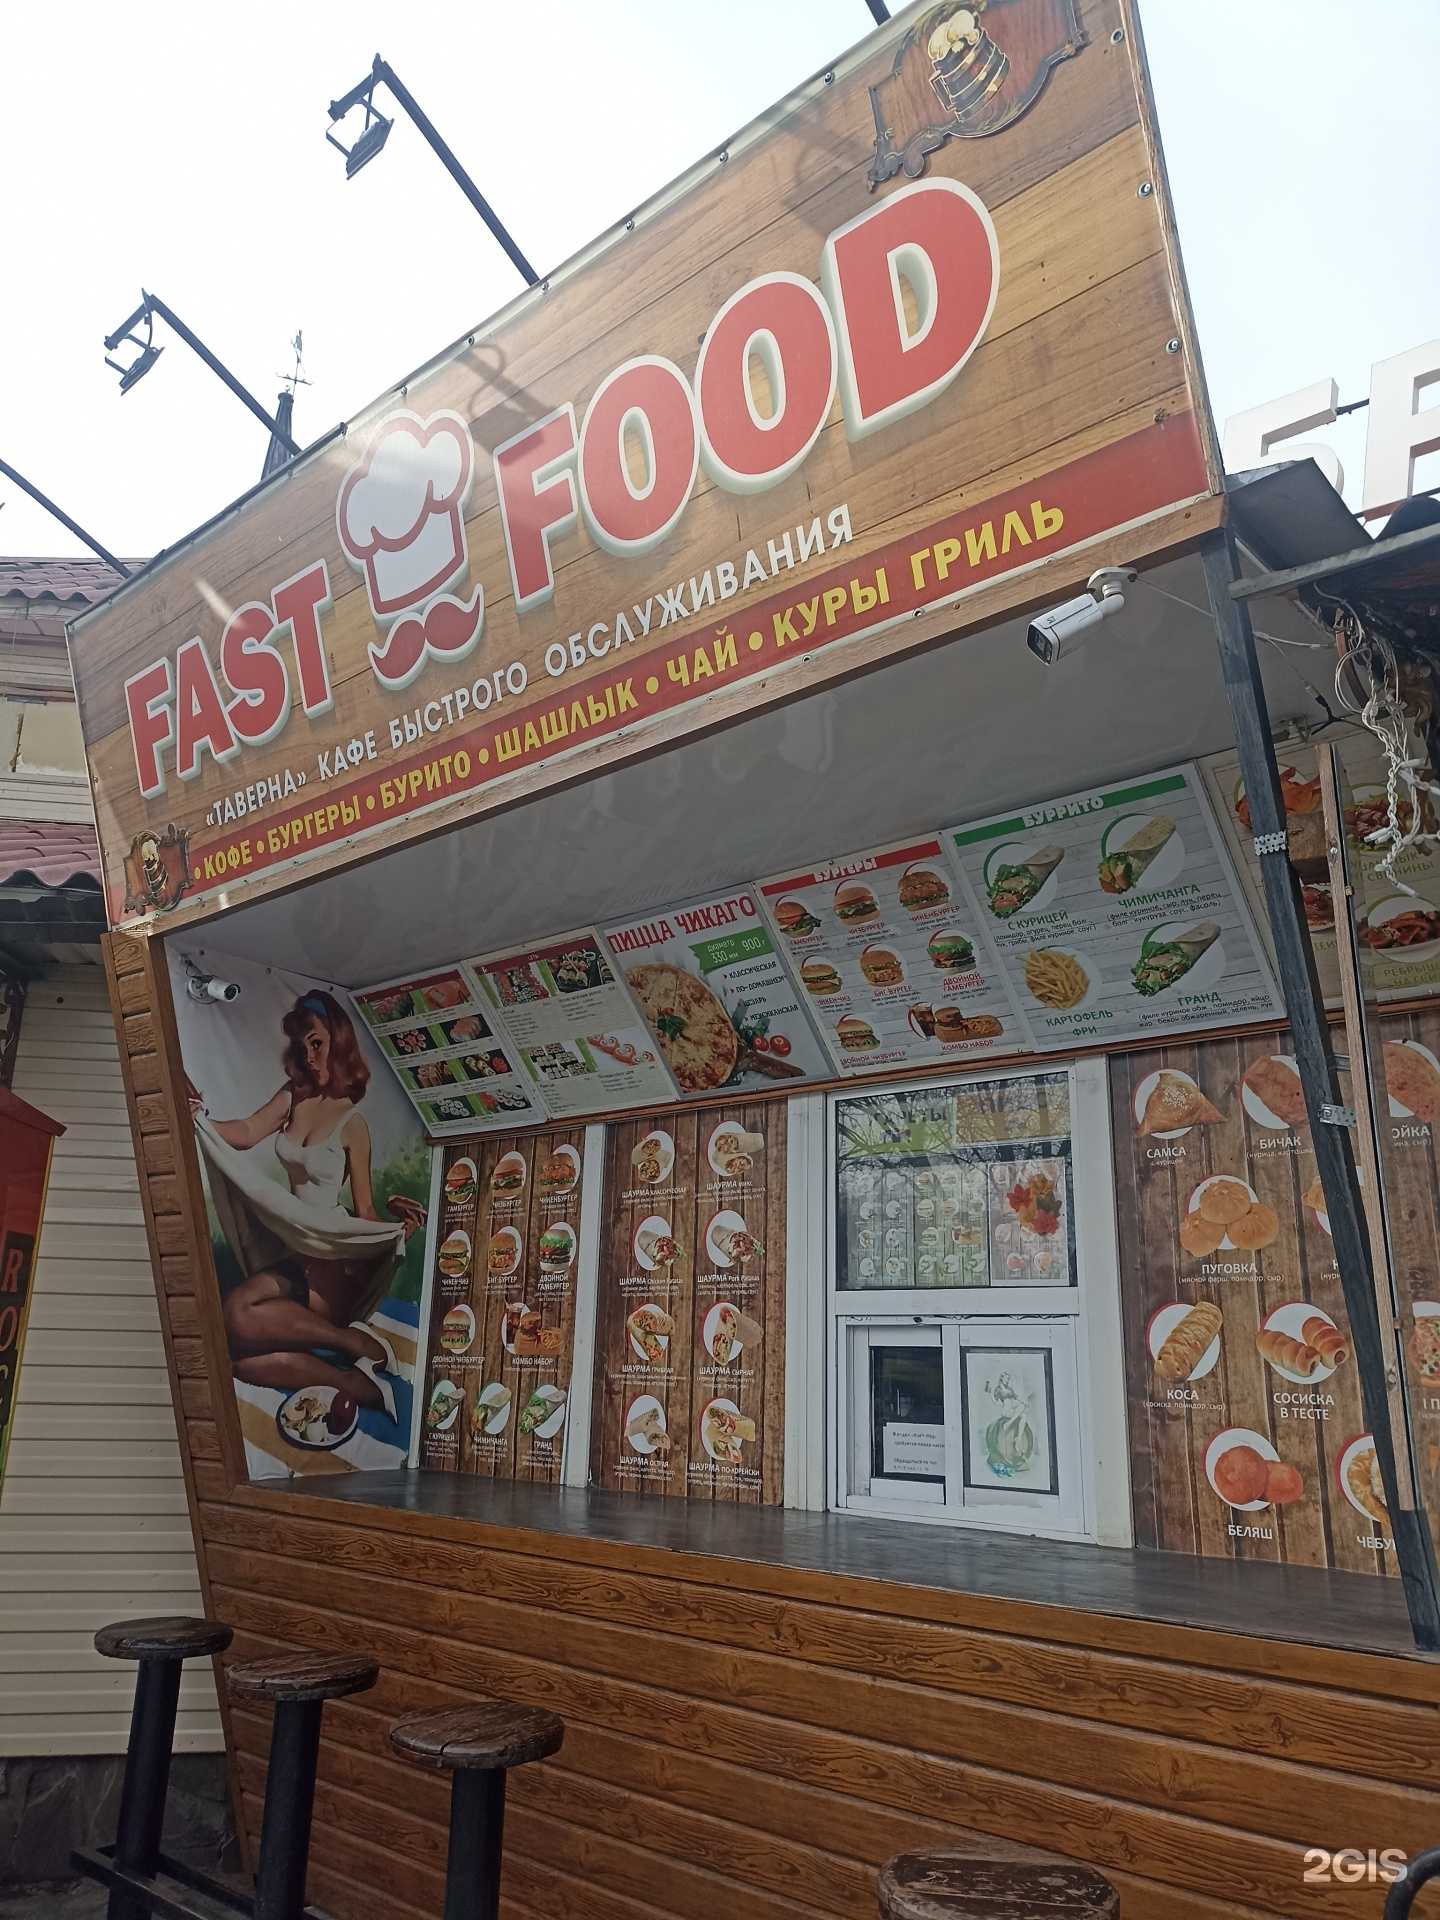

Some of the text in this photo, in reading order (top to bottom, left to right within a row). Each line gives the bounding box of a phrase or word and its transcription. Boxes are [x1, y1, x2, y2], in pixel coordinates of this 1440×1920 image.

[125, 176, 1001, 800] FAST FOOD
[206, 504, 853, 829] «ТАВЕРНА» КАФЕ БЫСТРОГО ОБСЛУЖИВАНИЯ
[203, 499, 1065, 881] КОФЕ БУРГЕРЫ БУРИТО ШАШЛЫК ЧАЙ КУРЫ ГРИЛЬ
[1023, 796, 1105, 829] БУРРИТО
[814, 858, 878, 883] БУРГЕРЫ
[1118, 883, 1201, 910] ЧИМИЧАНГА
[607, 896, 757, 955] ПИЦЦА ЧИКАГО
[1017, 909, 1069, 931] КУРИЦЕЙ
[742, 937, 760, 952] 900
[711, 950, 728, 965] 330
[1177, 991, 1222, 1007] ГРАНД
[1046, 1009, 1113, 1027] КАРТОФЕЛЬ
[1072, 1025, 1097, 1037] ФРИ
[969, 1038, 994, 1050] НАБОР
[1259, 1136, 1301, 1150] БИЧАК
[1146, 1145, 1187, 1160] САМСА
[706, 1181, 737, 1191] ШАУРМА
[622, 1189, 649, 1199] ШАУРМА
[1201, 1262, 1258, 1275] ПУГОВКА
[619, 1278, 647, 1287] ШАУРМА
[697, 1274, 727, 1283] ШАУРМА
[622, 1364, 651, 1373] ШАУРМА
[699, 1366, 731, 1376] ШАУРМА
[1167, 1389, 1199, 1401] КОСА
[1273, 1392, 1335, 1406] СОСИСКА
[1280, 1408, 1329, 1421] В ТЕСТЕ
[619, 1456, 649, 1467] ШАУРМА
[689, 1462, 720, 1473] ШАУРМА
[1227, 1524, 1273, 1540] БЕЛЯШ
